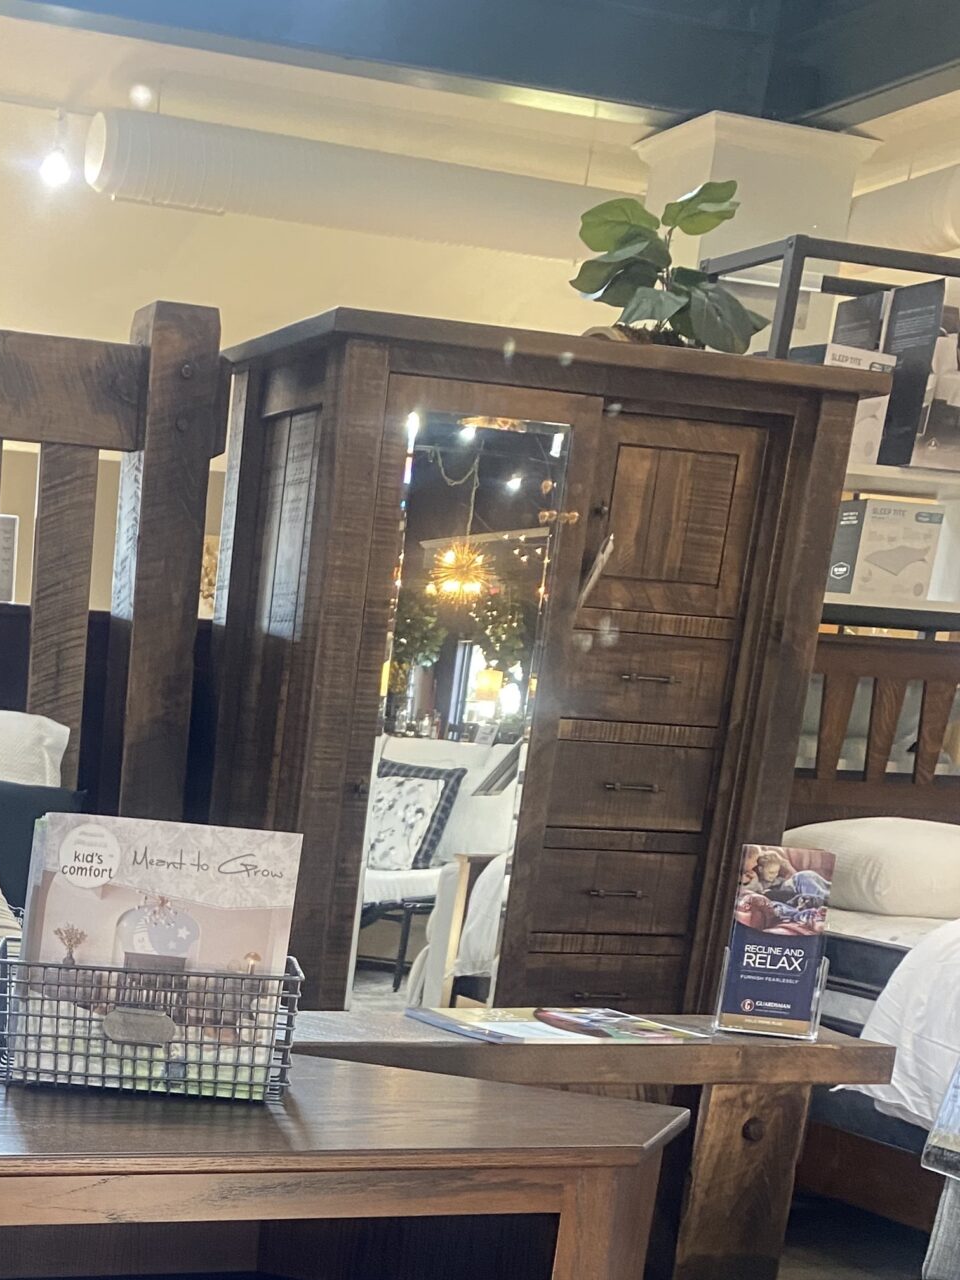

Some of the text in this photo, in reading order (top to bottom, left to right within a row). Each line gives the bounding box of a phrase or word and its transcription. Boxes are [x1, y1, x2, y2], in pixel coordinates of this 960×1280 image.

[831, 353, 849, 364] SLEEP
[73, 850, 104, 865] kid's
[132, 846, 285, 880] Meant to Grow
[61, 863, 113, 880] comfort
[744, 944, 805, 957] RECLINE AND
[742, 952, 804, 972] RELAX
[765, 976, 800, 985] FEARLESSLY
[755, 1000, 792, 1010] GUARDSMAN
